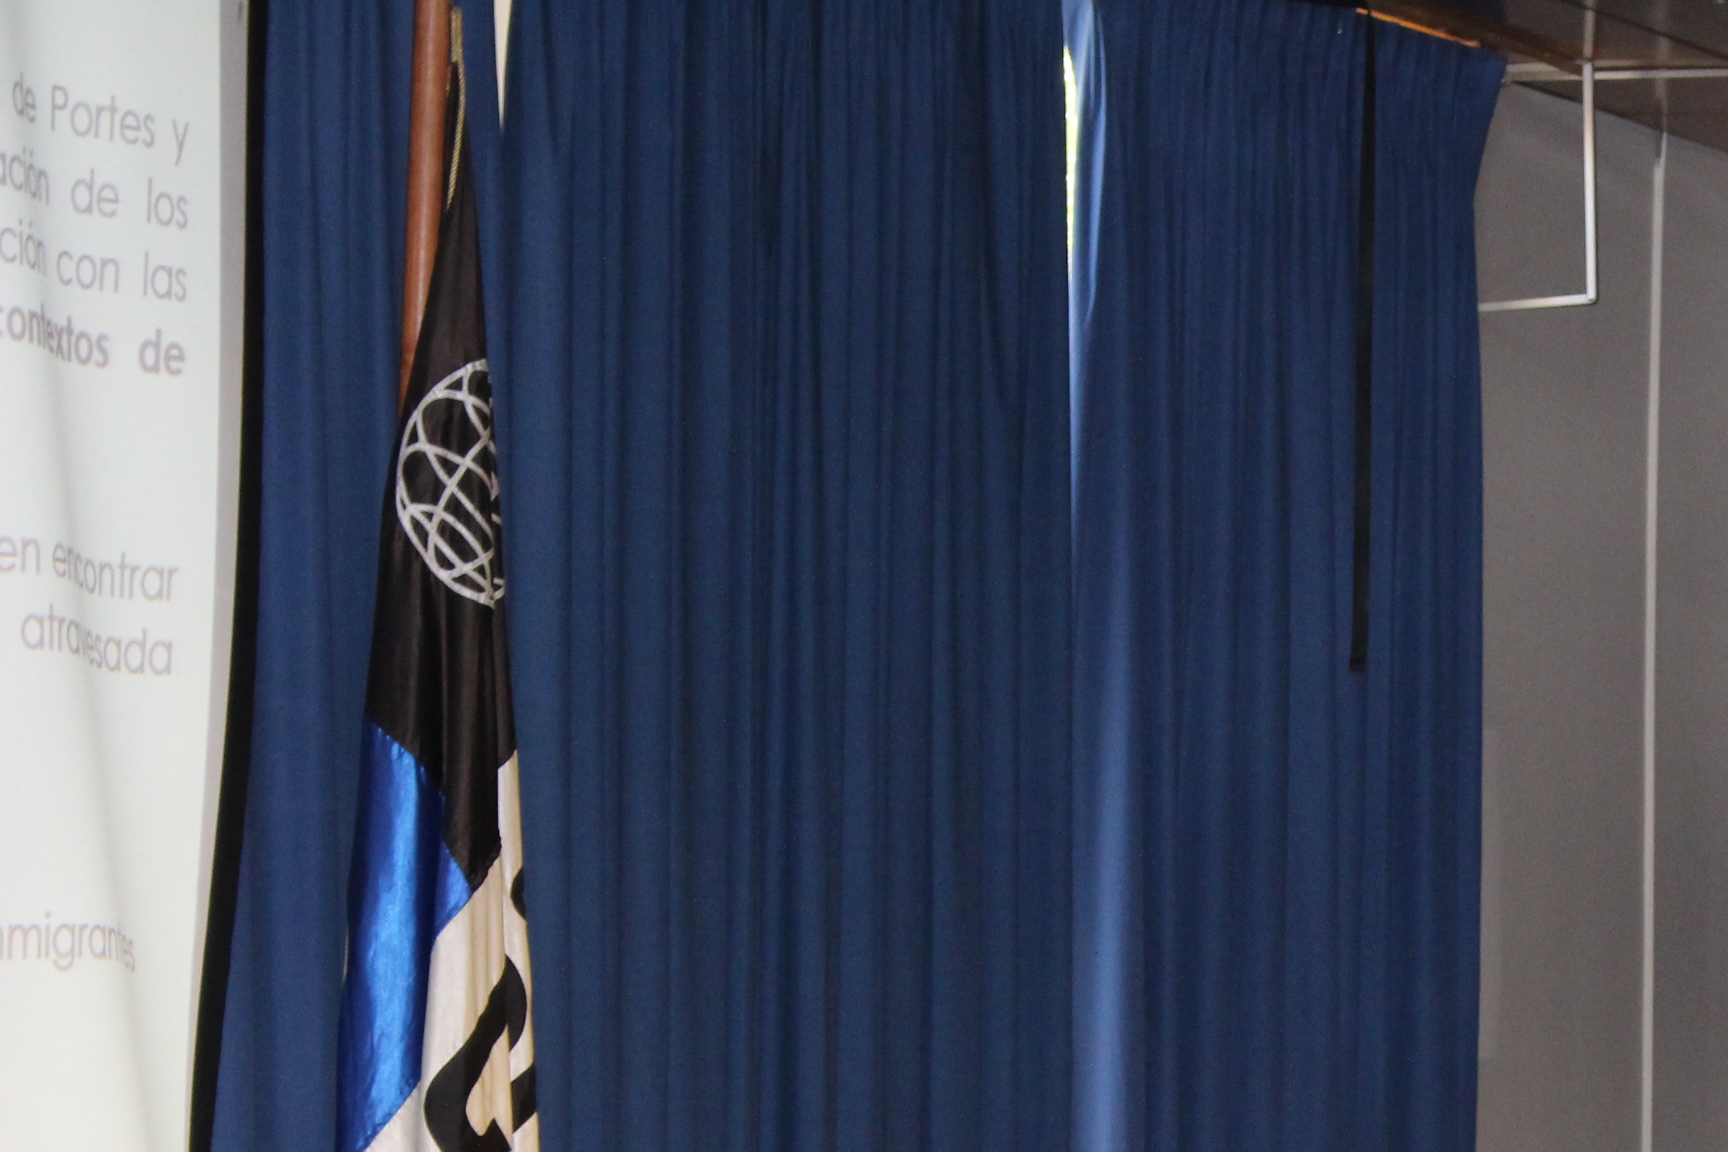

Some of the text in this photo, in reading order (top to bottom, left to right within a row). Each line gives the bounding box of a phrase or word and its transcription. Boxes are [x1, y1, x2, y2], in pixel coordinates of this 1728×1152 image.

[12, 72, 190, 166] de Portes y
[0, 146, 189, 229] ción de los
[56, 250, 120, 293] con
[143, 250, 187, 301] las
[0, 303, 186, 376] ontextos de
[52, 541, 180, 601] encontrar
